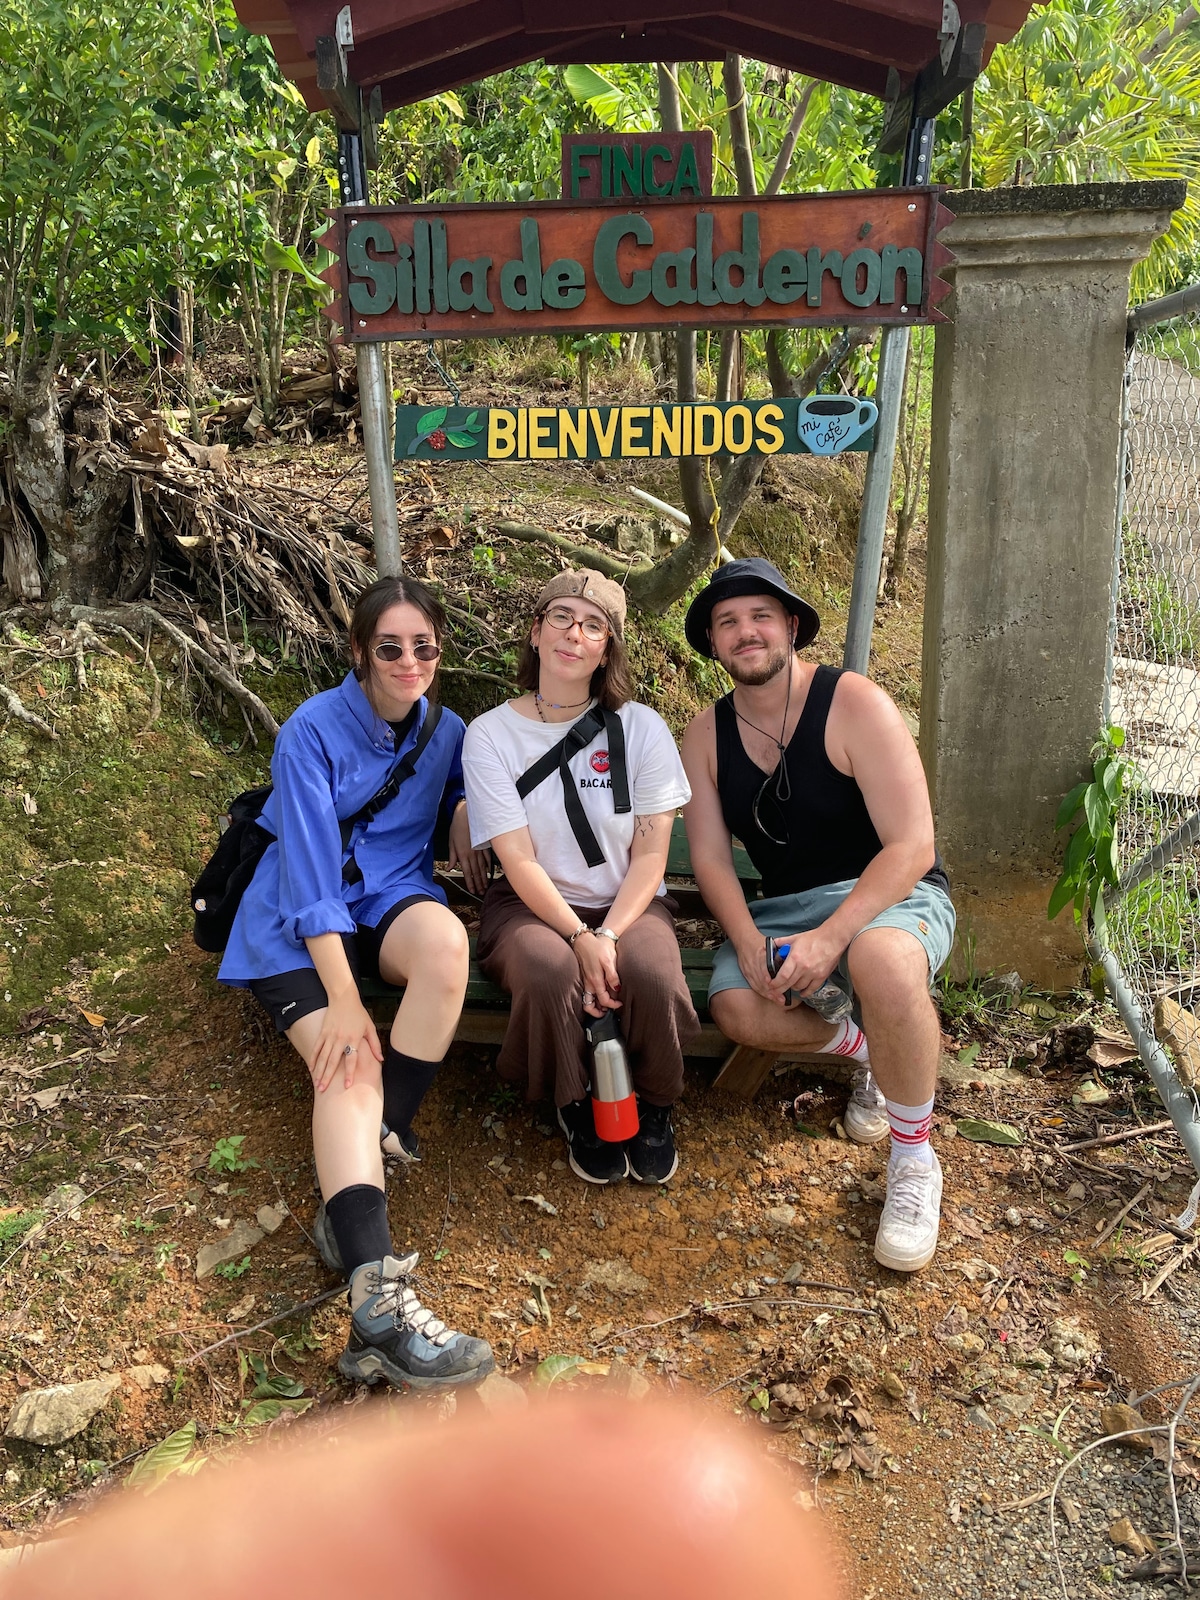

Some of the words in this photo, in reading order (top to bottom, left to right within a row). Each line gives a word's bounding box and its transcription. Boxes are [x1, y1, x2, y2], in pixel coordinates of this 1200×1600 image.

[570, 143, 701, 198] FINCA
[347, 216, 494, 315] Silla
[501, 216, 586, 312] de
[593, 211, 924, 308] Calderón
[487, 404, 785, 459] BIENVENIDOS
[801, 417, 821, 435] mi
